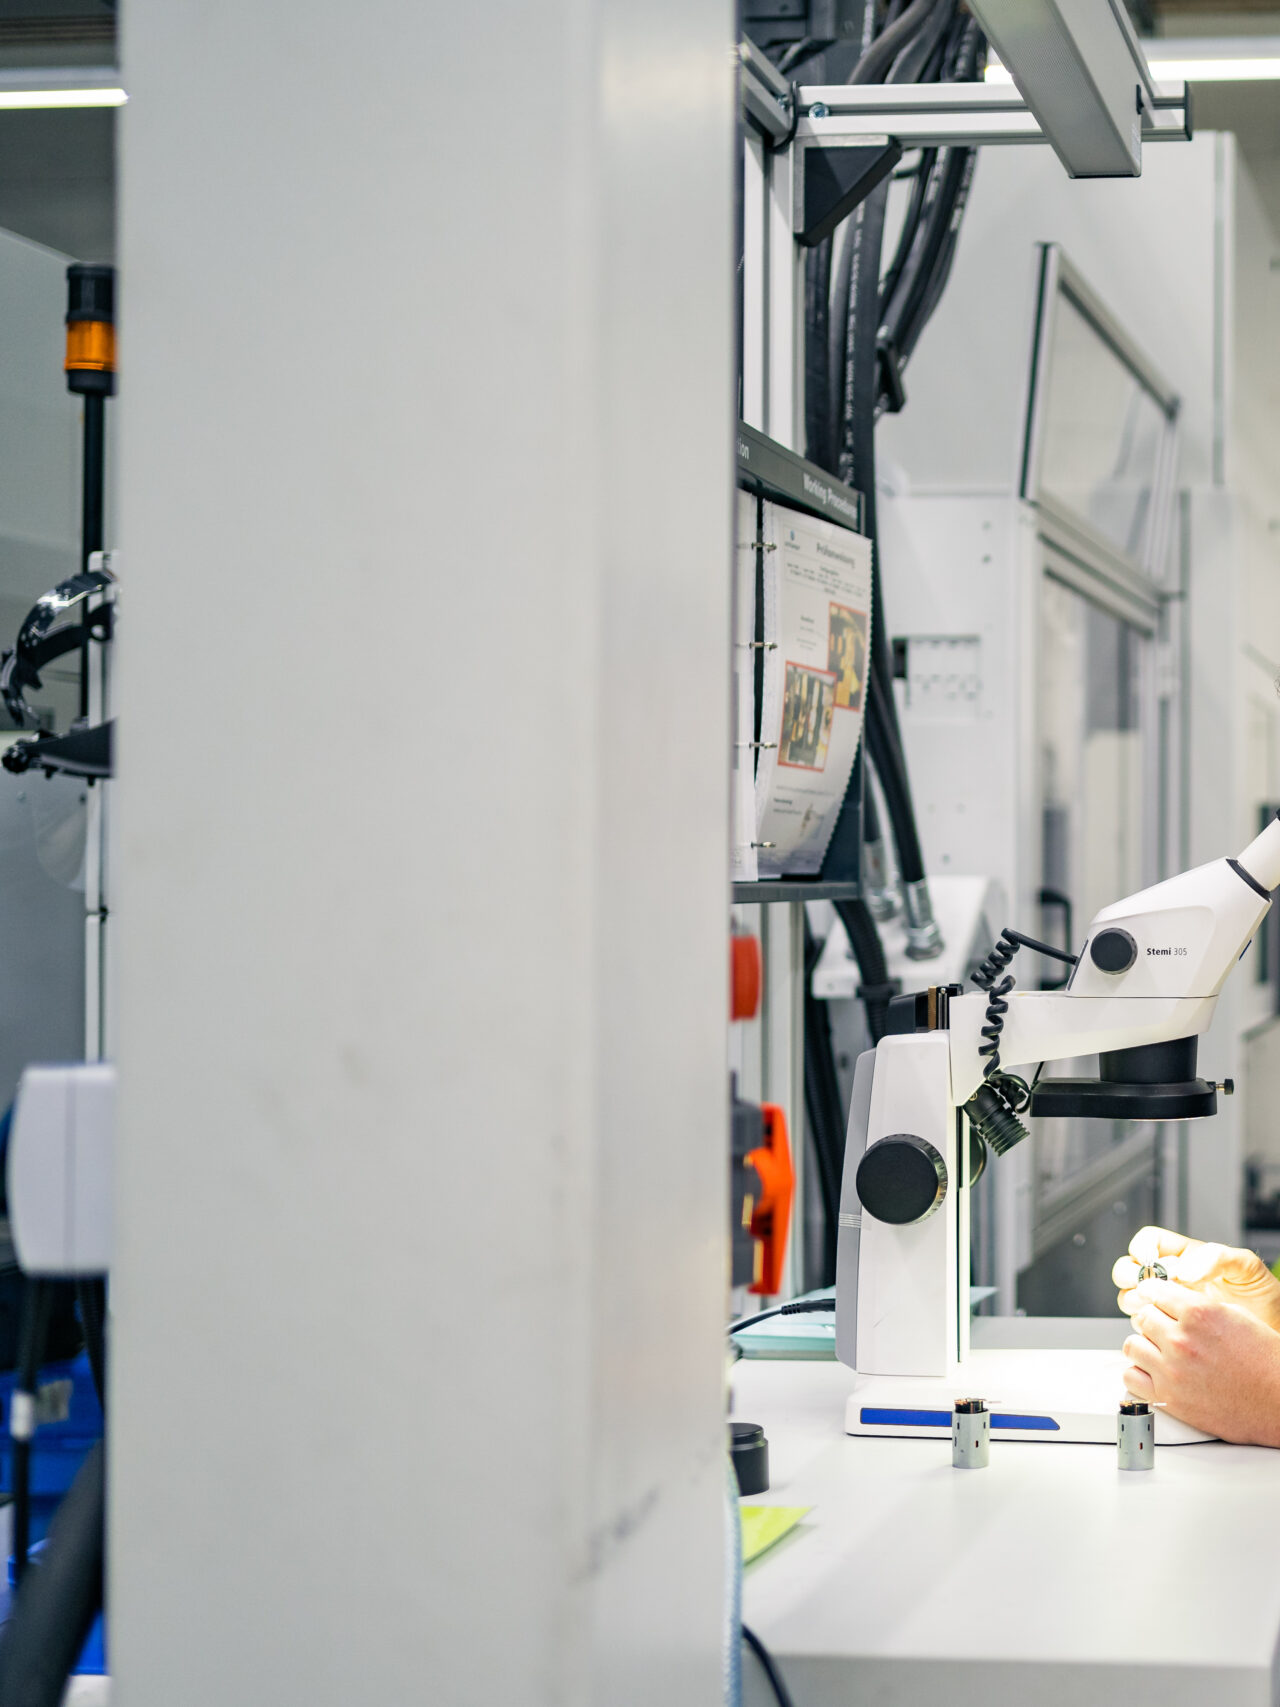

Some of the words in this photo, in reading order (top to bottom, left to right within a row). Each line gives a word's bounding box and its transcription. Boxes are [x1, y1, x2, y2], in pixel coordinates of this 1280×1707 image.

[803, 472, 827, 505] Working
[1146, 947, 1172, 956] Stemi
[1173, 947, 1188, 956] 305
